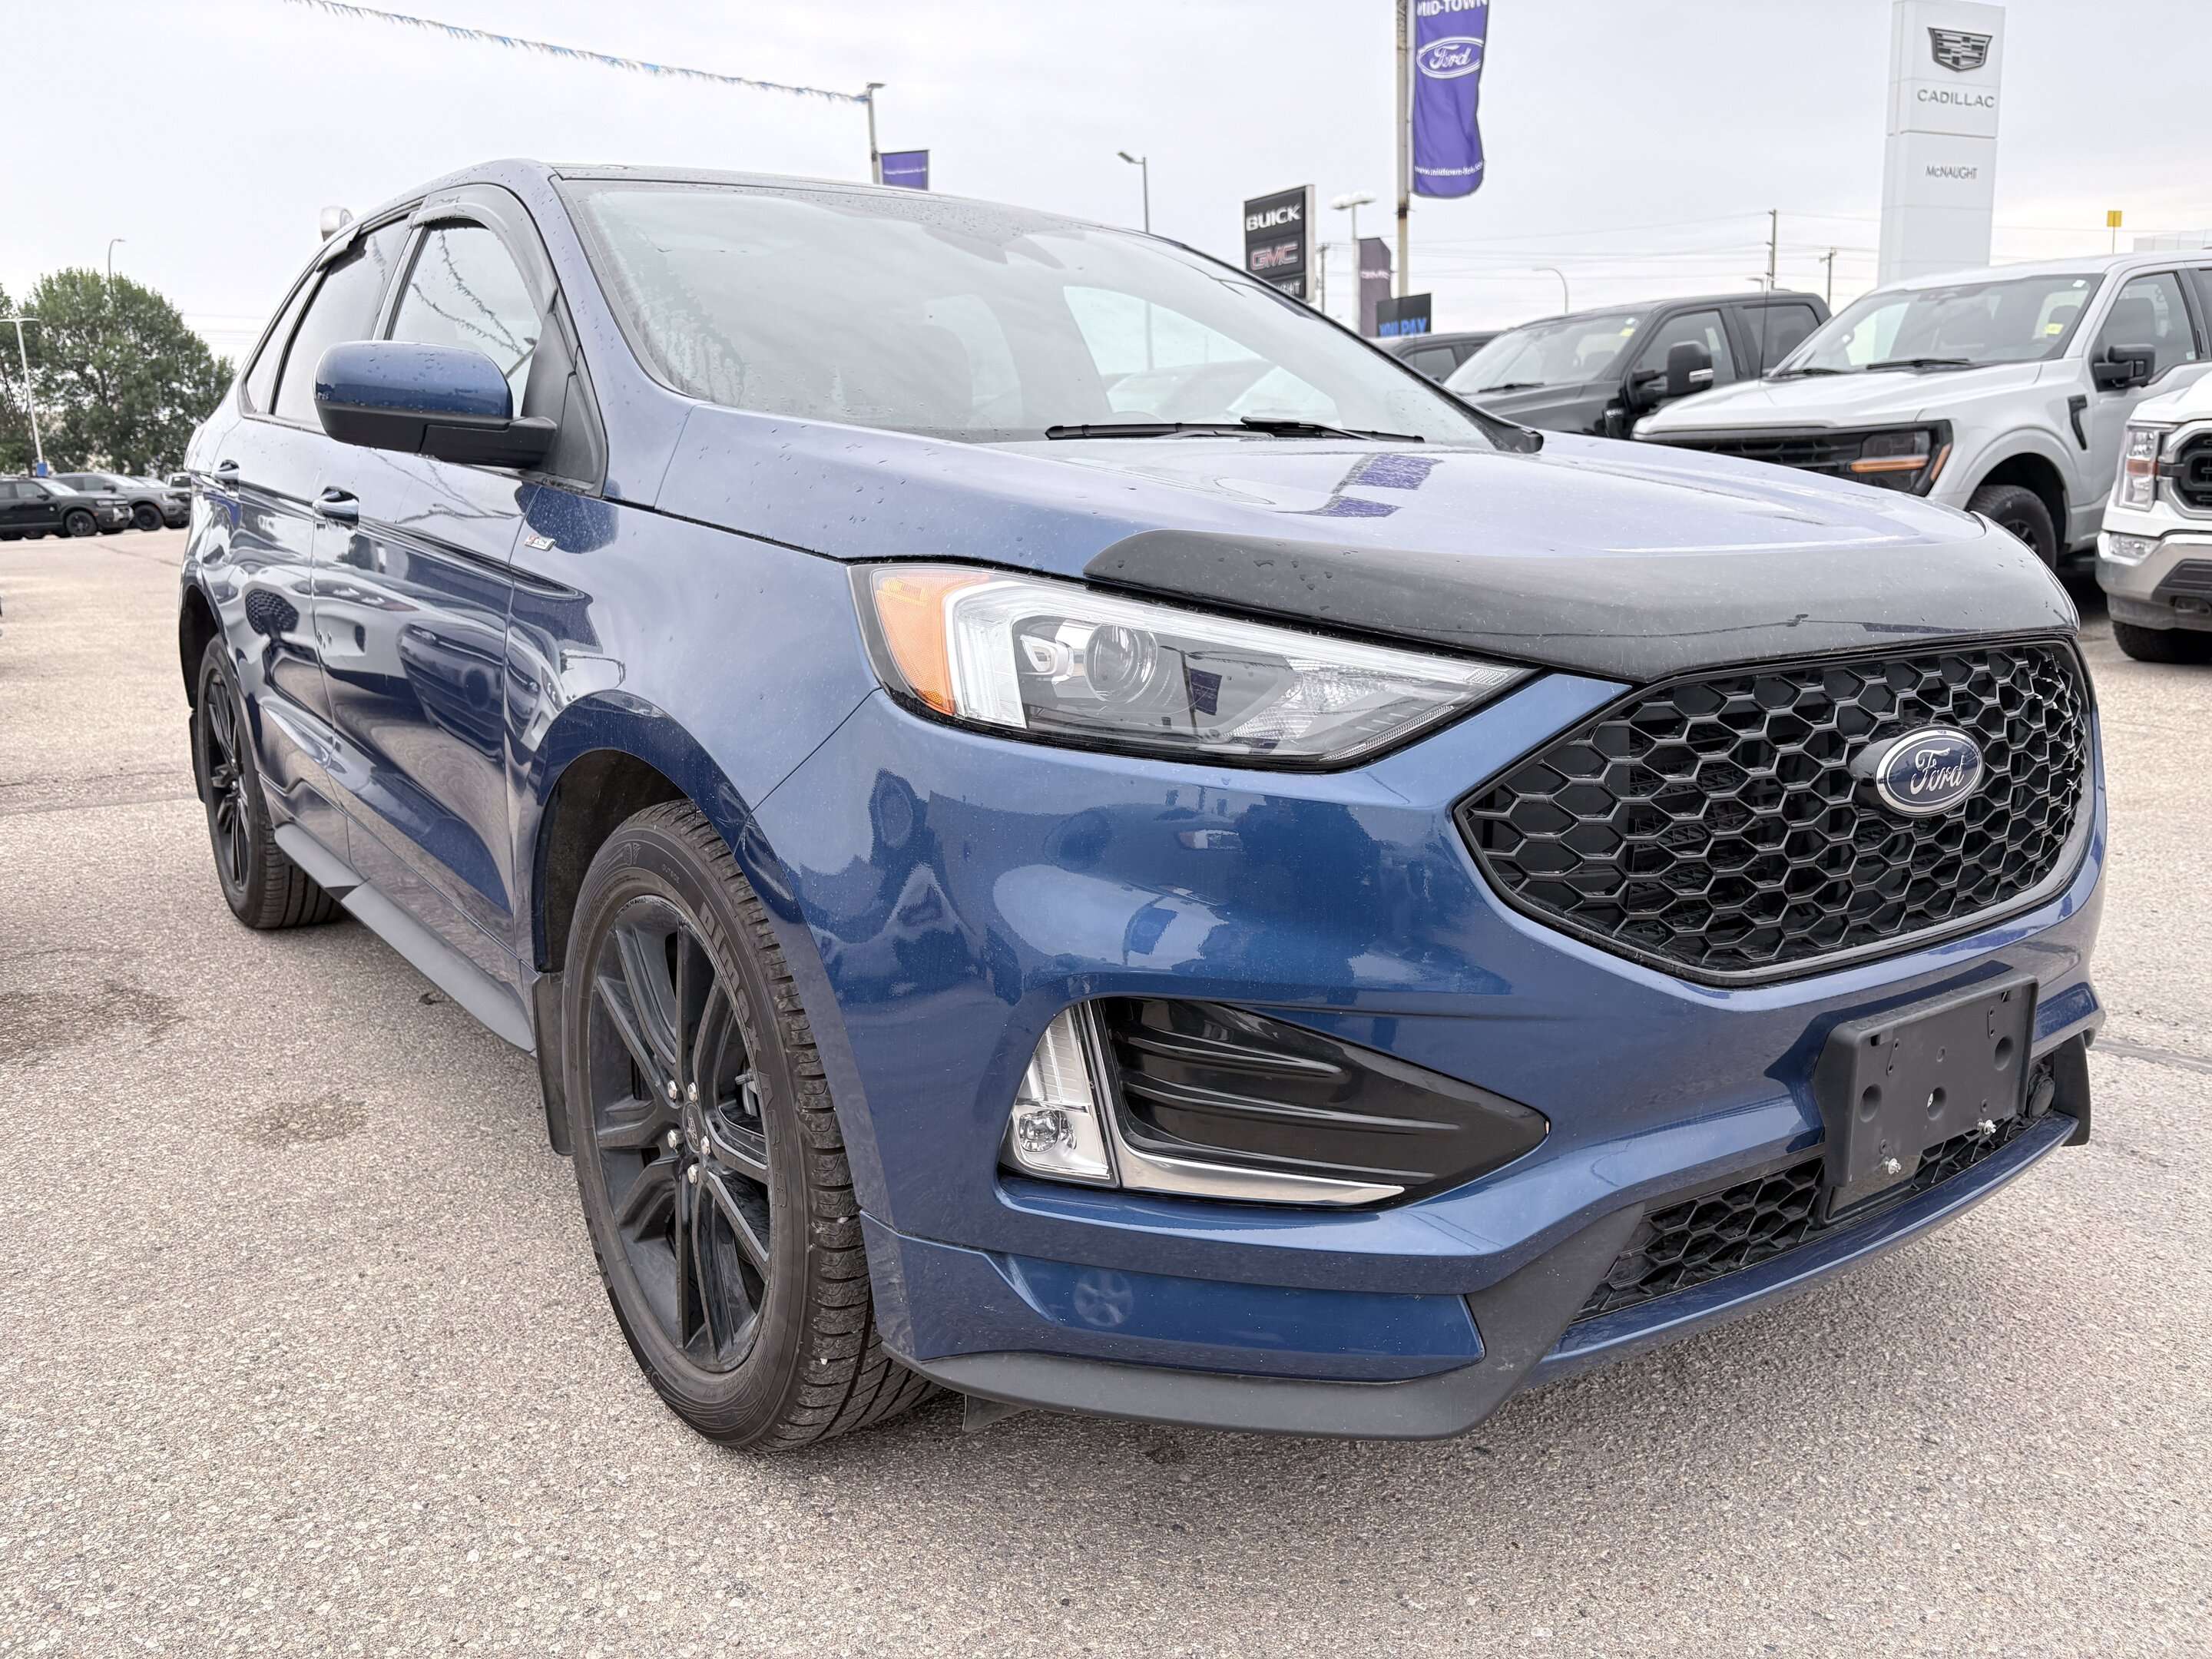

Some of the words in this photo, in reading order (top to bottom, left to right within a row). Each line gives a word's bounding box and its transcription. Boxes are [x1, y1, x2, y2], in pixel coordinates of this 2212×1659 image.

[1429, 44, 1471, 69] Ford
[1916, 88, 1995, 108] CADILLAC
[1245, 204, 1301, 231] BUICK
[1250, 240, 1298, 270] GMC
[1400, 316, 1427, 336] PAY
[1909, 747, 1965, 795] Ford
